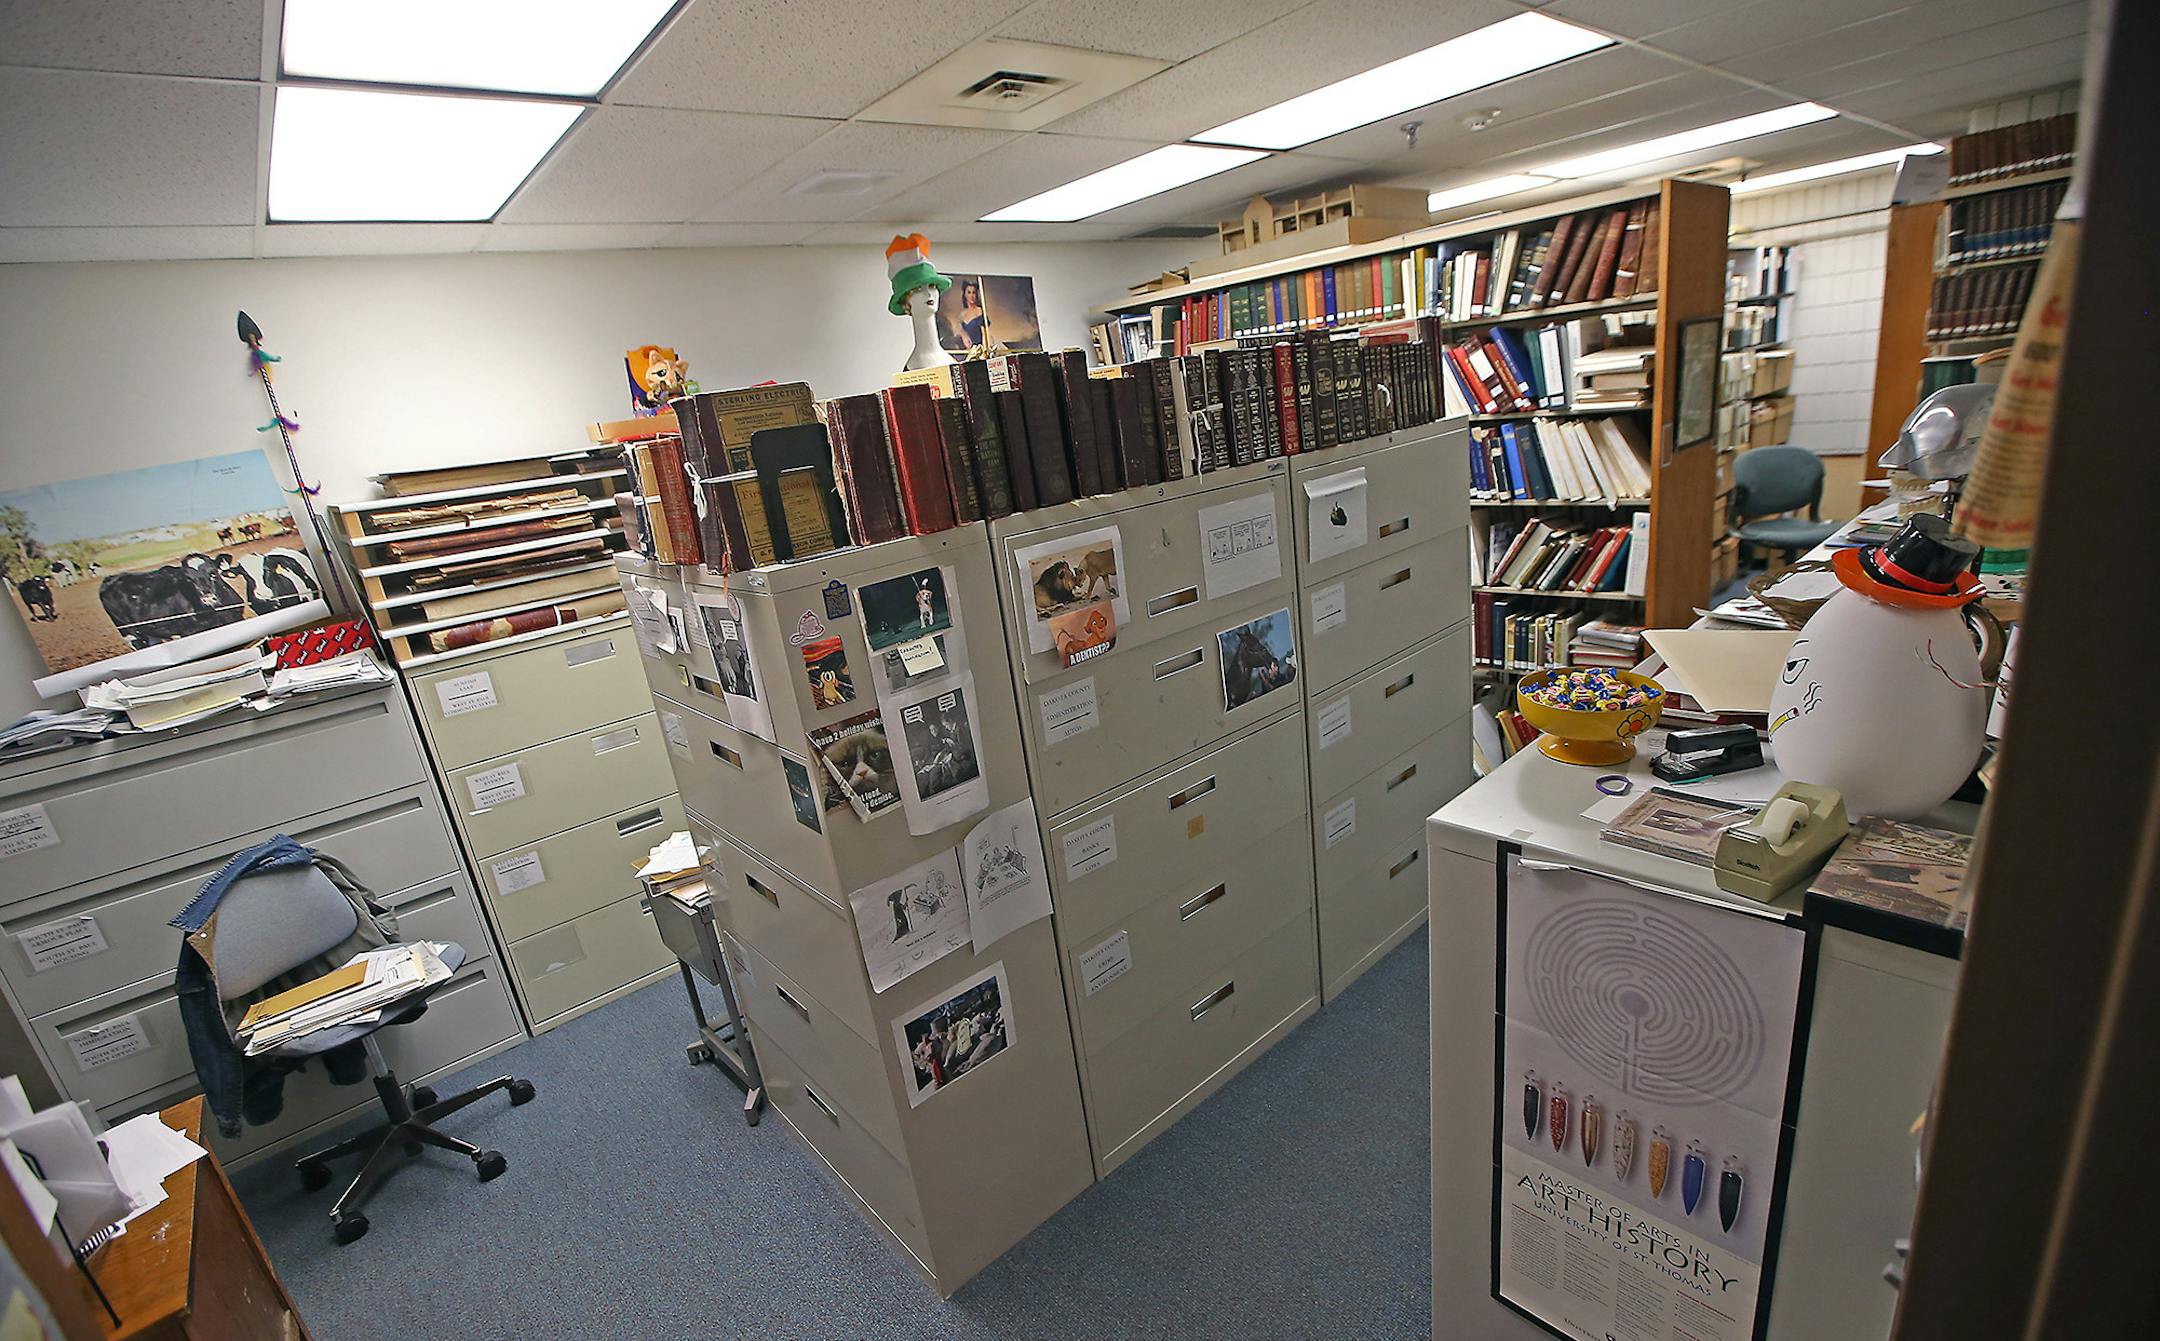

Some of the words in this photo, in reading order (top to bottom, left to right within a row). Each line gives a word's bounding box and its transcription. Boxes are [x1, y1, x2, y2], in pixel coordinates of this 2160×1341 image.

[718, 394, 761, 405] STERLING
[764, 388, 805, 400] ELECTRIC
[1070, 654, 1076, 666] A
[1043, 694, 1068, 708] DAKOTA
[1068, 684, 1091, 698] COUNTY
[838, 722, 865, 740] holiday
[864, 716, 884, 730] wish
[1066, 832, 1090, 847] DAKOTA
[1090, 823, 1111, 836] COUNTY
[27, 931, 54, 942] SOUTH
[39, 952, 66, 963] SOUTH
[1538, 1172, 1604, 1210] MASTER
[1609, 1206, 1631, 1222] OF
[1637, 1221, 1682, 1248] ARTS
[1689, 1245, 1710, 1264] IN
[1517, 1175, 1578, 1212] ART
[1588, 1207, 1739, 1292] HISTORY
[1534, 1200, 1608, 1242] UNIVERSITY
[1612, 1240, 1628, 1254] OF
[1634, 1252, 1650, 1266] ST.
[1653, 1262, 1712, 1296] THOMAS
